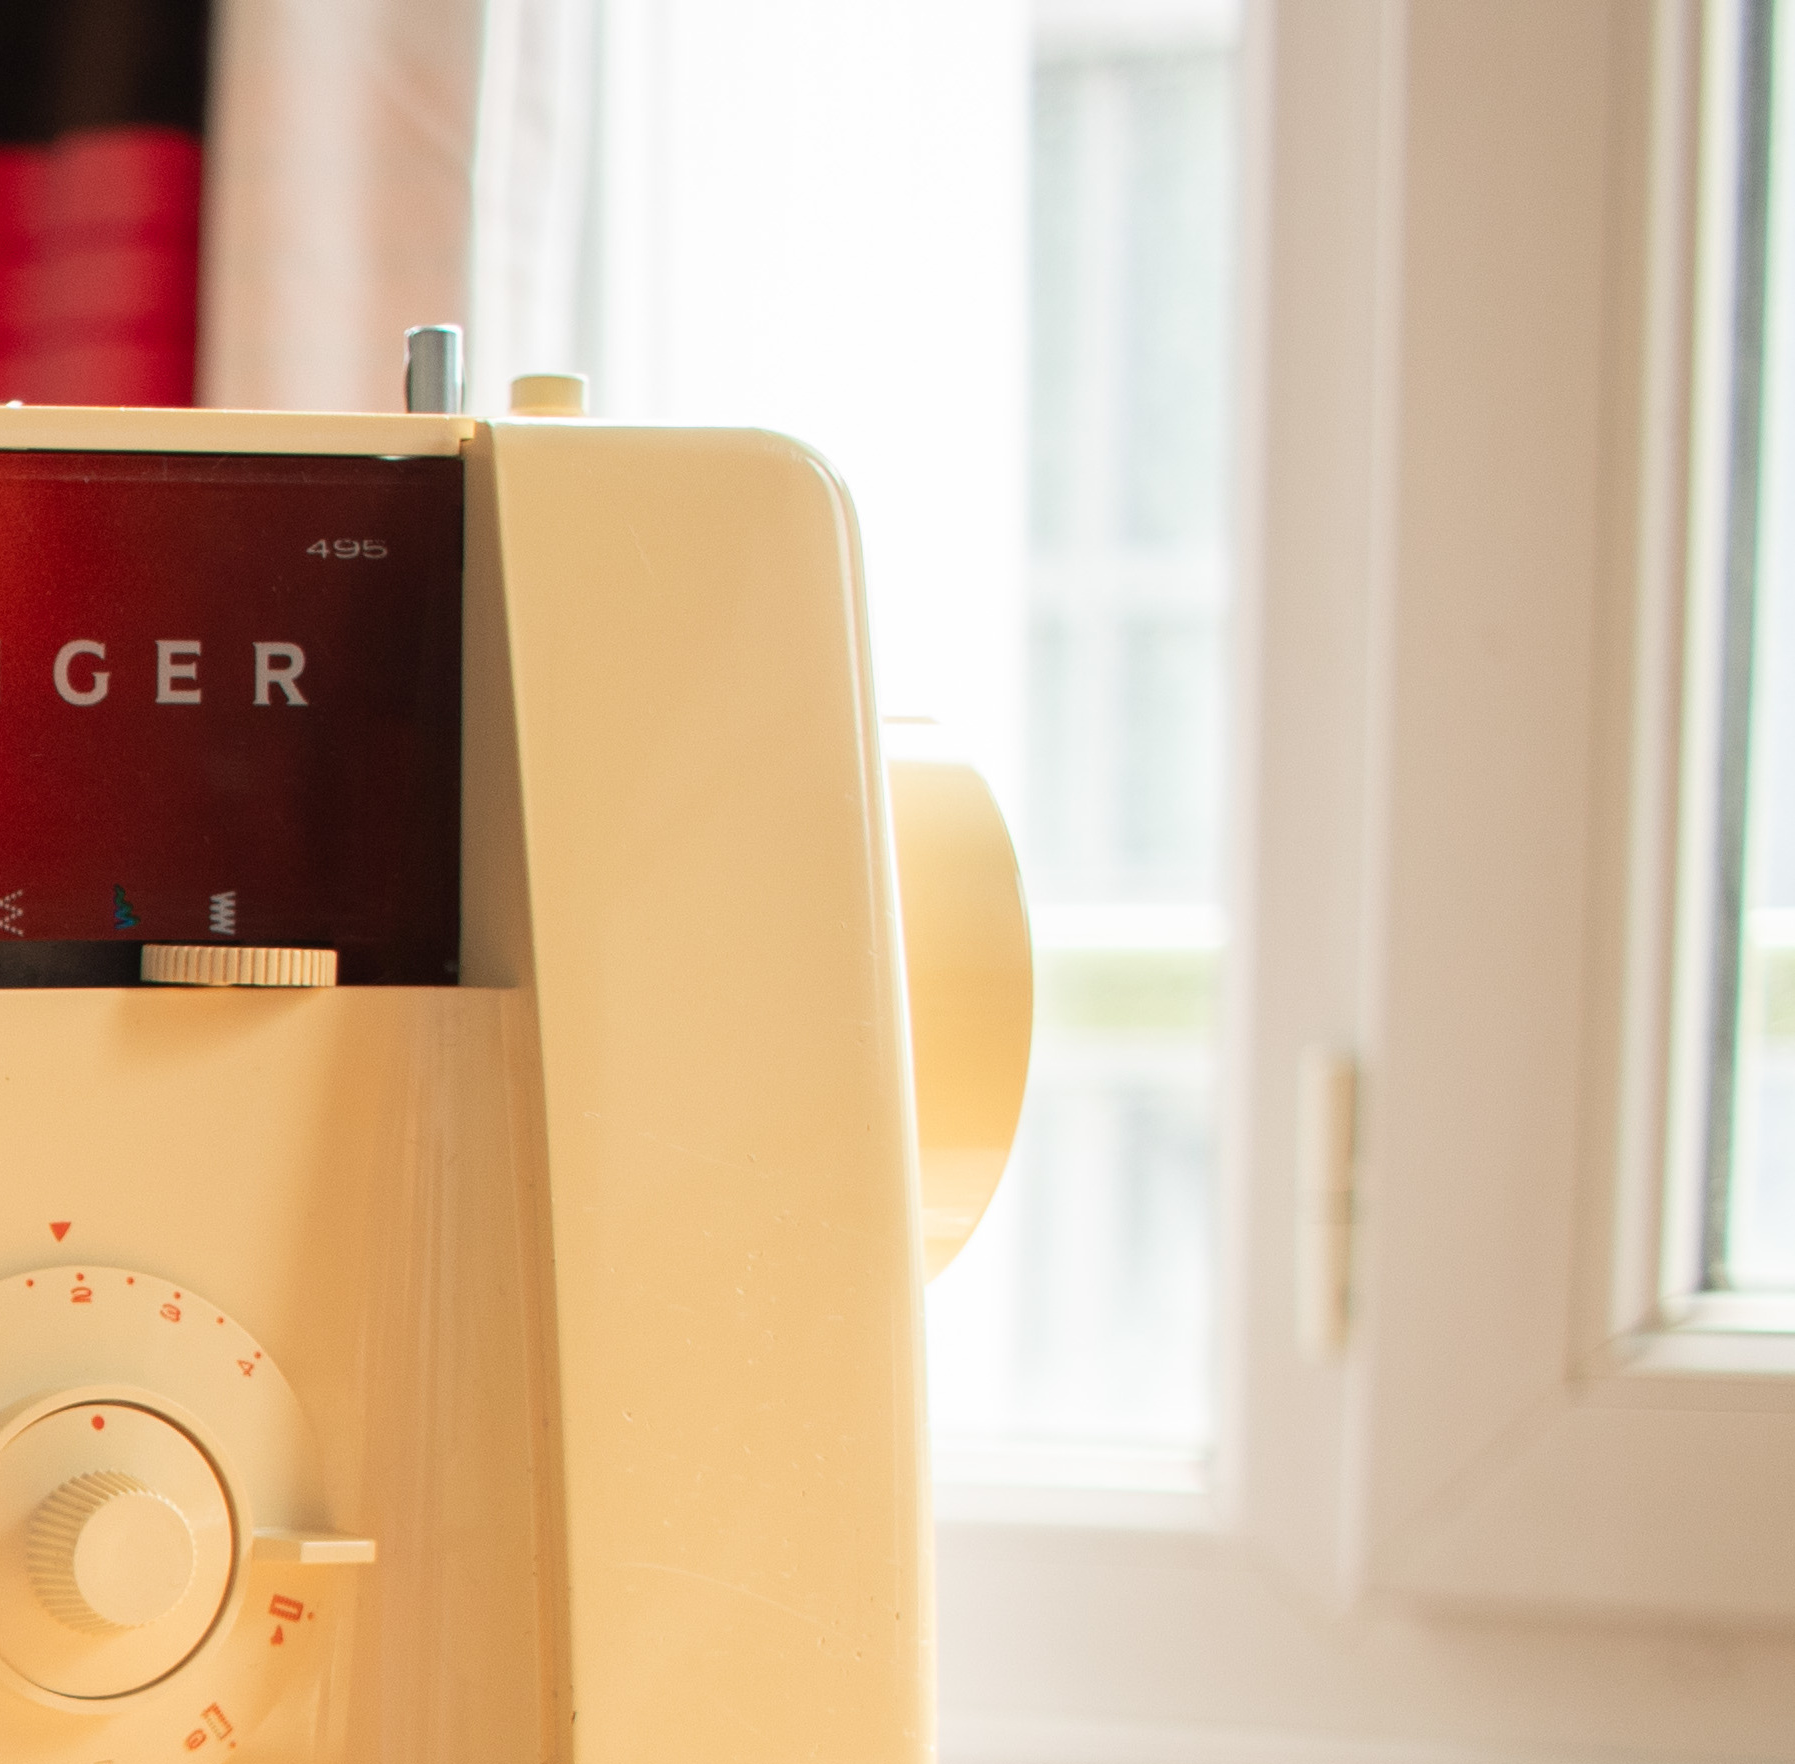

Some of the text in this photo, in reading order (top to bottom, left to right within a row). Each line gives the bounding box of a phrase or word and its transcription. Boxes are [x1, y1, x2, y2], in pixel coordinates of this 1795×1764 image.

[306, 538, 388, 560] 495
[70, 1285, 93, 1304] 2
[159, 1302, 182, 1324] 3
[236, 1357, 256, 1378] 4
